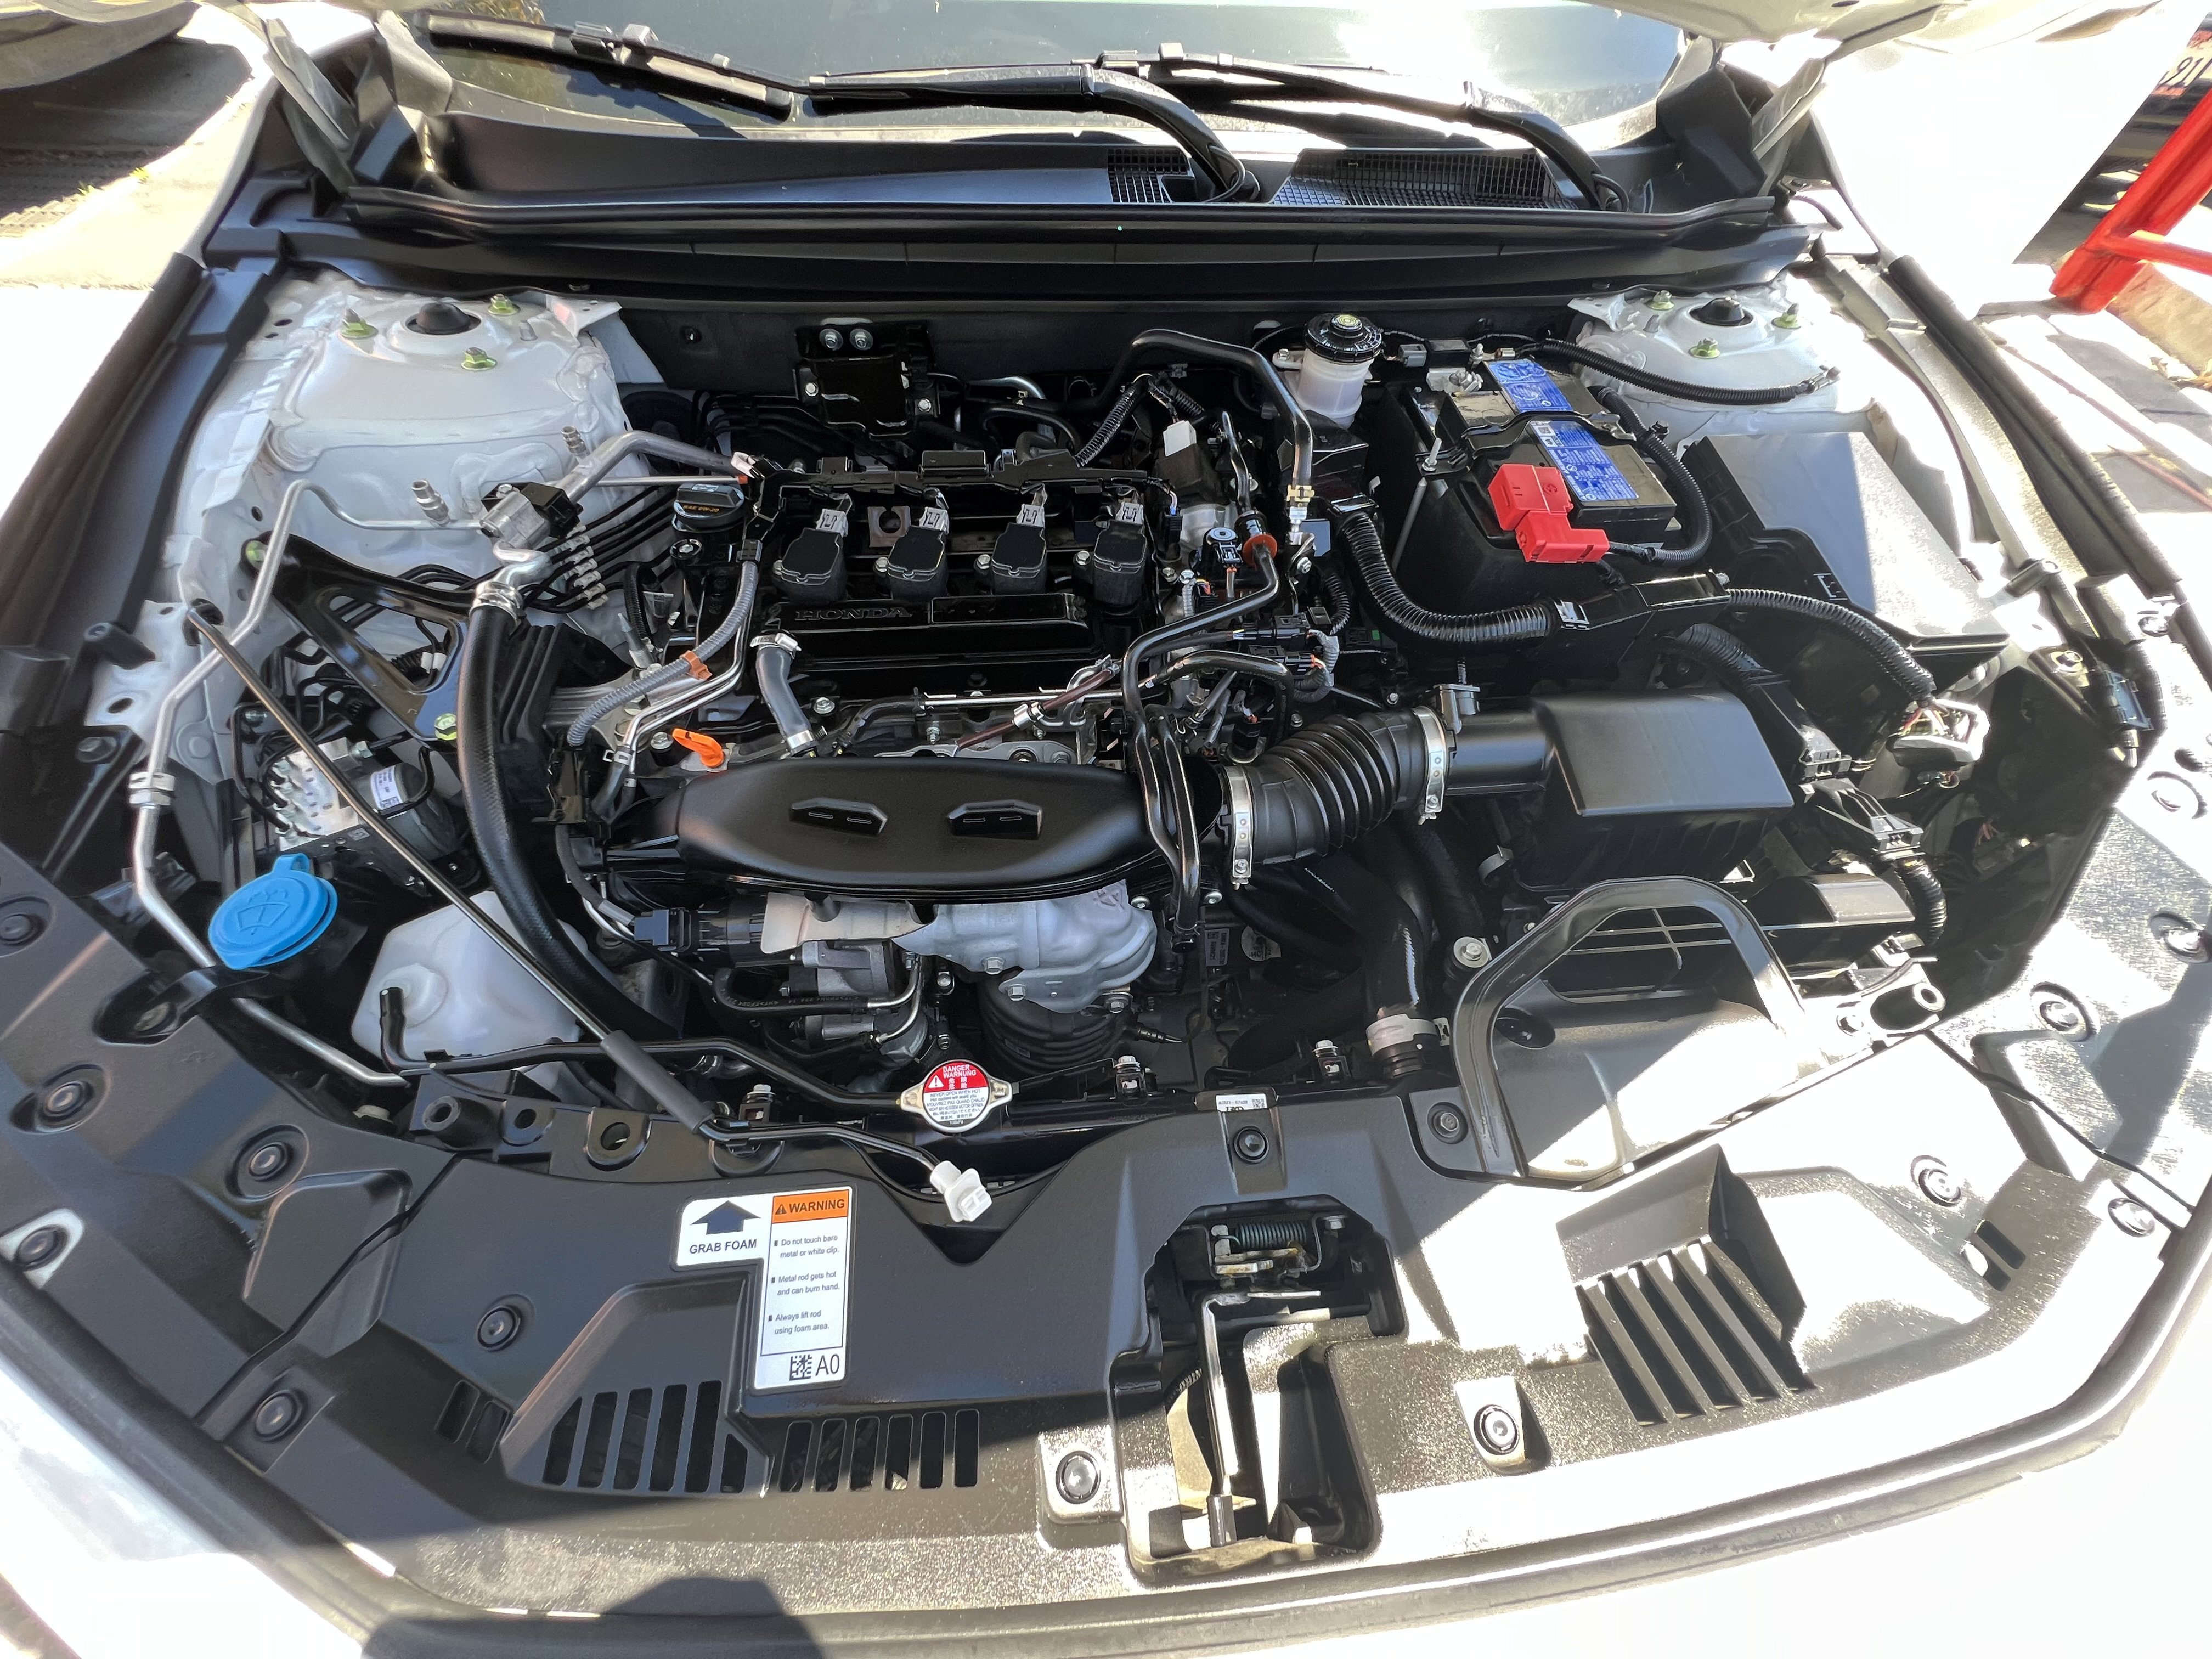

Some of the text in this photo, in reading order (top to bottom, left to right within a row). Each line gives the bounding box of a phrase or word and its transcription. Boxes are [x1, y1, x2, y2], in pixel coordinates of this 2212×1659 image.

[795, 607, 912, 620] HONDA
[944, 1069, 977, 1079] WARNUNG
[789, 1199, 845, 1212] WARNING
[804, 1235, 821, 1244] touch
[690, 1239, 757, 1254] GRAB FOAM
[811, 1273, 824, 1282] gets
[810, 1309, 821, 1317] rod
[816, 1354, 839, 1376] A0
